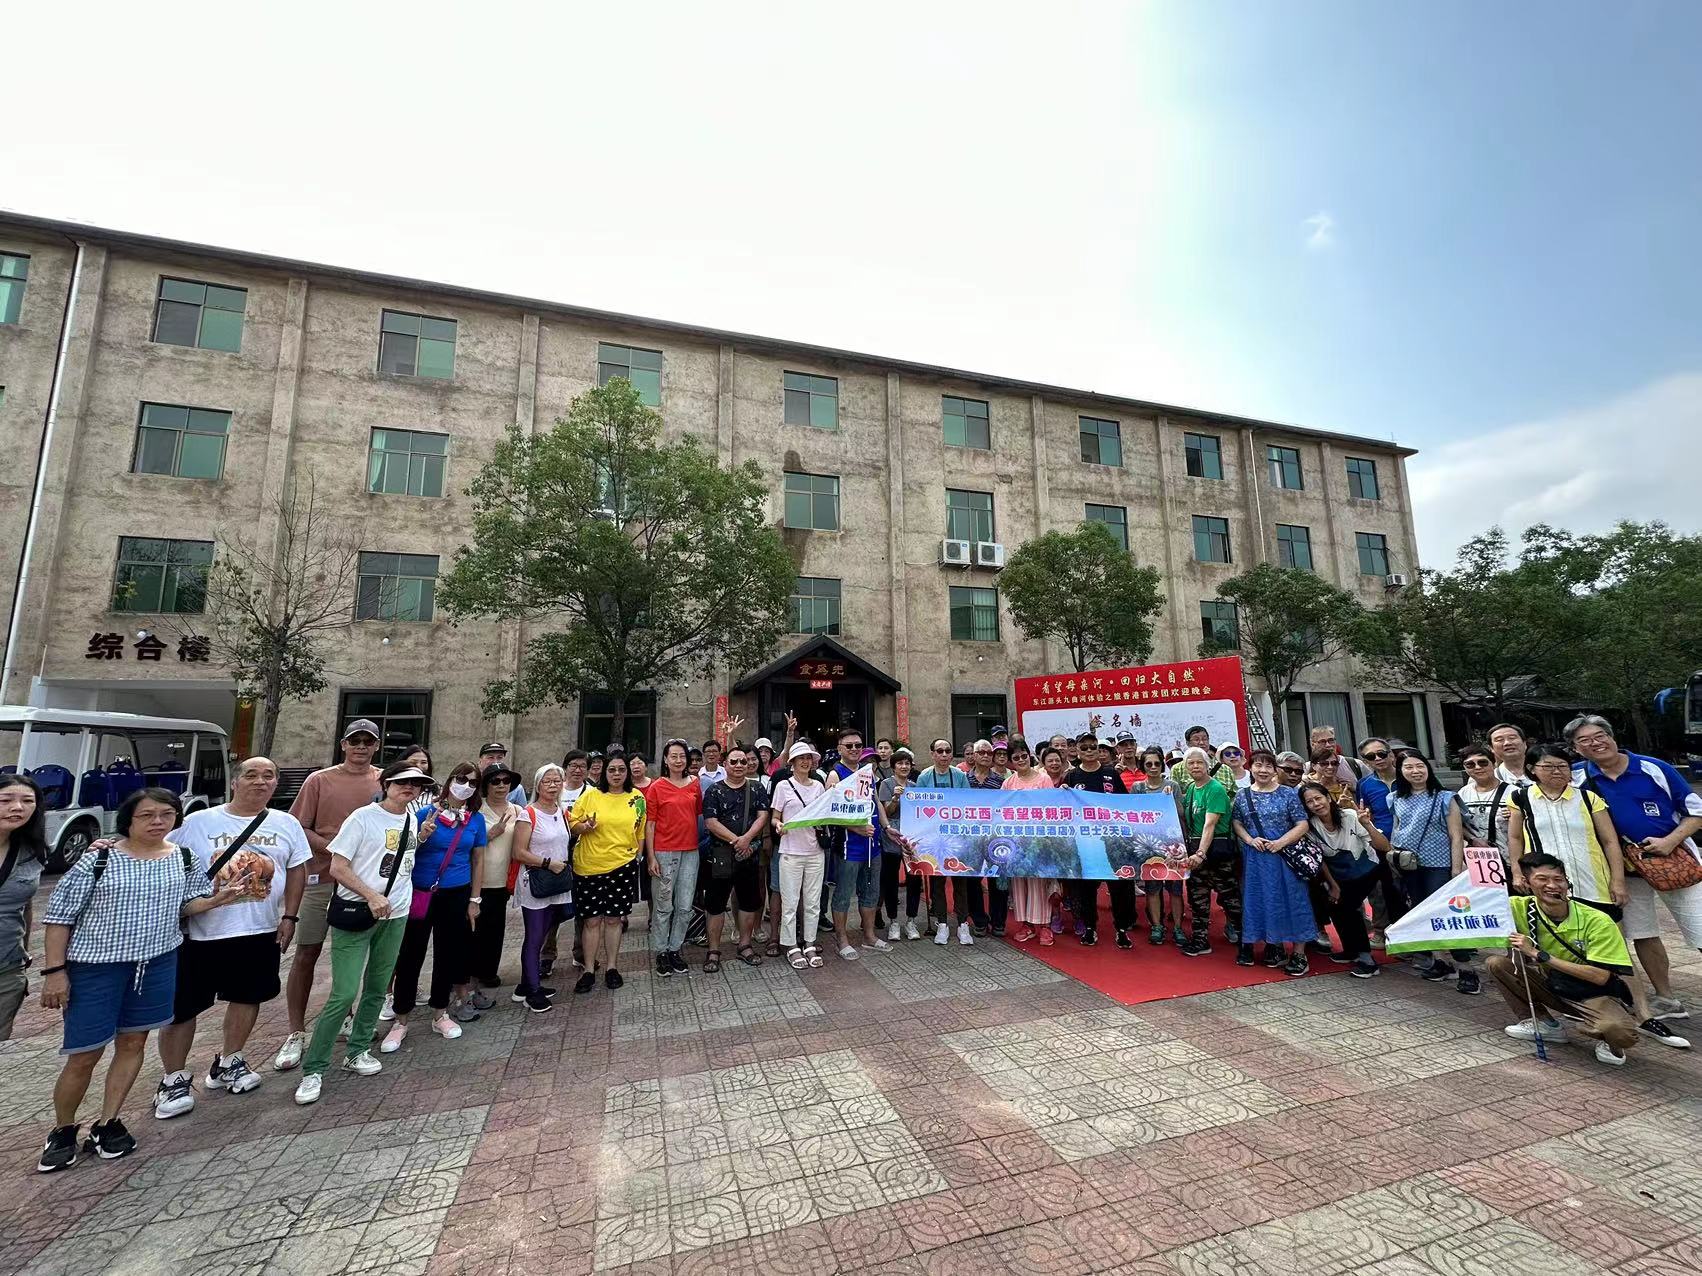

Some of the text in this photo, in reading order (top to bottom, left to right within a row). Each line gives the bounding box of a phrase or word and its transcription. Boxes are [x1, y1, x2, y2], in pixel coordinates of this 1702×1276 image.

[85, 633, 210, 662] 综合楼
[859, 780, 870, 797] 73
[1475, 860, 1502, 885] 18
[1430, 914, 1500, 932] 廣東旅遊
